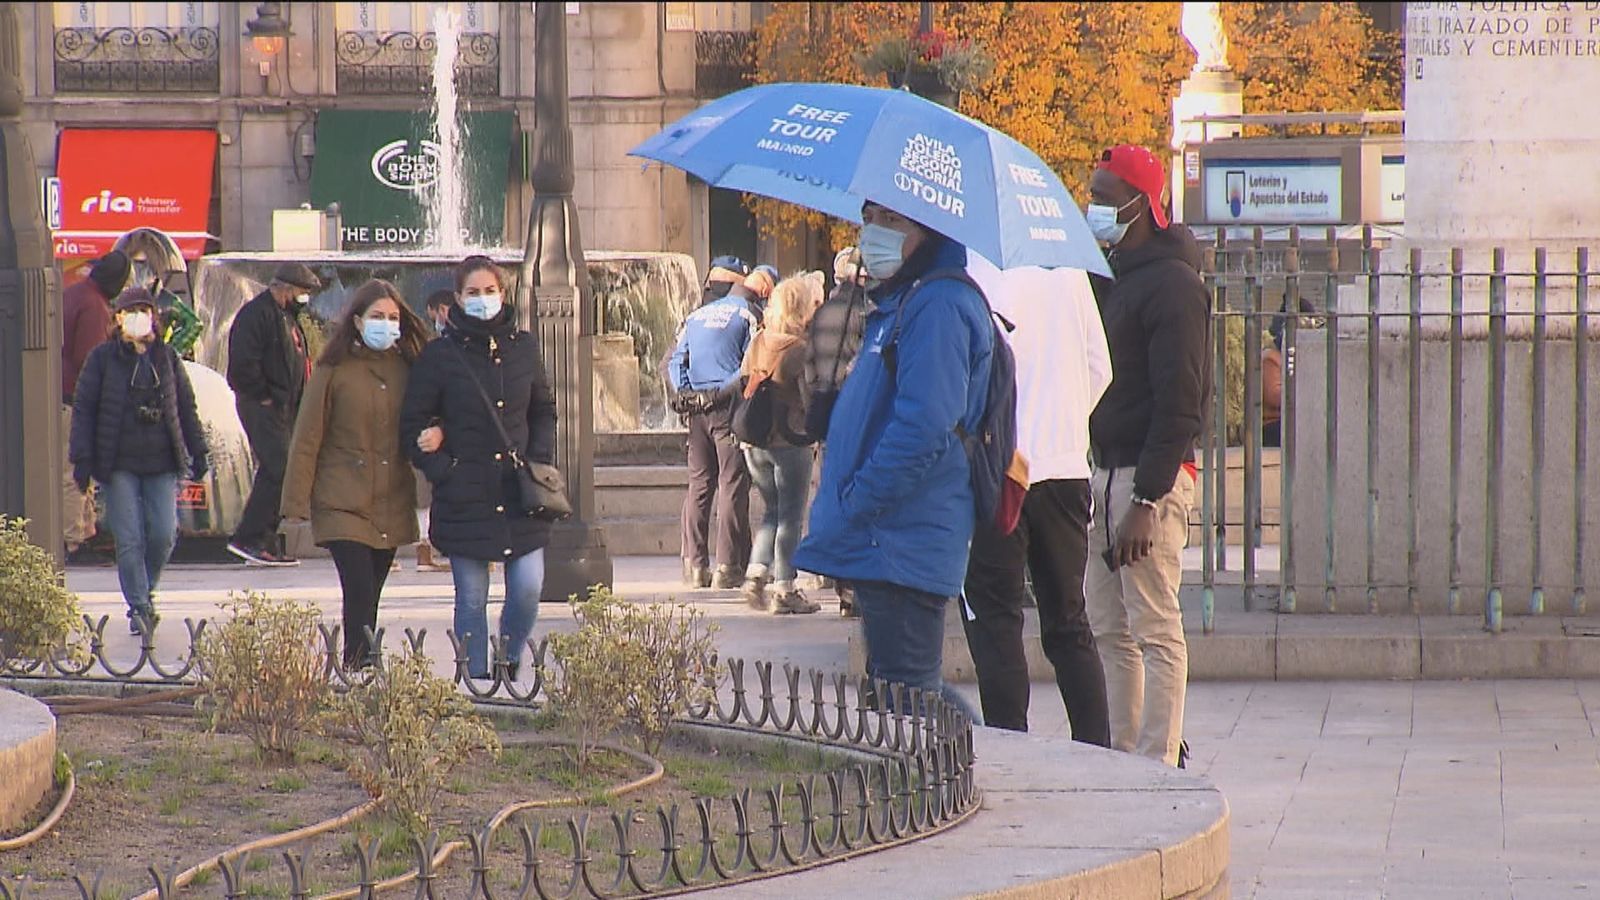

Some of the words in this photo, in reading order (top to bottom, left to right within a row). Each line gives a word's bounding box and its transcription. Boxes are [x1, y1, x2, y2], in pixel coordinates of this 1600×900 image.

[1439, 17, 1529, 35] TRAZADO
[1545, 17, 1573, 34] DE
[1463, 39, 1476, 56] Y
[1492, 39, 1600, 57] CEMENTER
[787, 103, 853, 125] FREE
[769, 118, 838, 144] TOUR
[757, 138, 815, 157] MADRID
[906, 137, 962, 170] TOLEDO
[913, 132, 956, 157] AVILA
[399, 154, 427, 163] THE
[903, 146, 962, 182] SEGOVIA
[900, 156, 964, 195] ESCORIAL
[1007, 162, 1048, 189] FREE
[80, 189, 134, 214] ria
[1015, 193, 1064, 219] TOUR
[1249, 191, 1286, 208] Apuestas
[1287, 190, 1299, 205] del
[1300, 190, 1329, 205] Estado
[56, 239, 78, 254] ria
[375, 227, 420, 243] BODY
